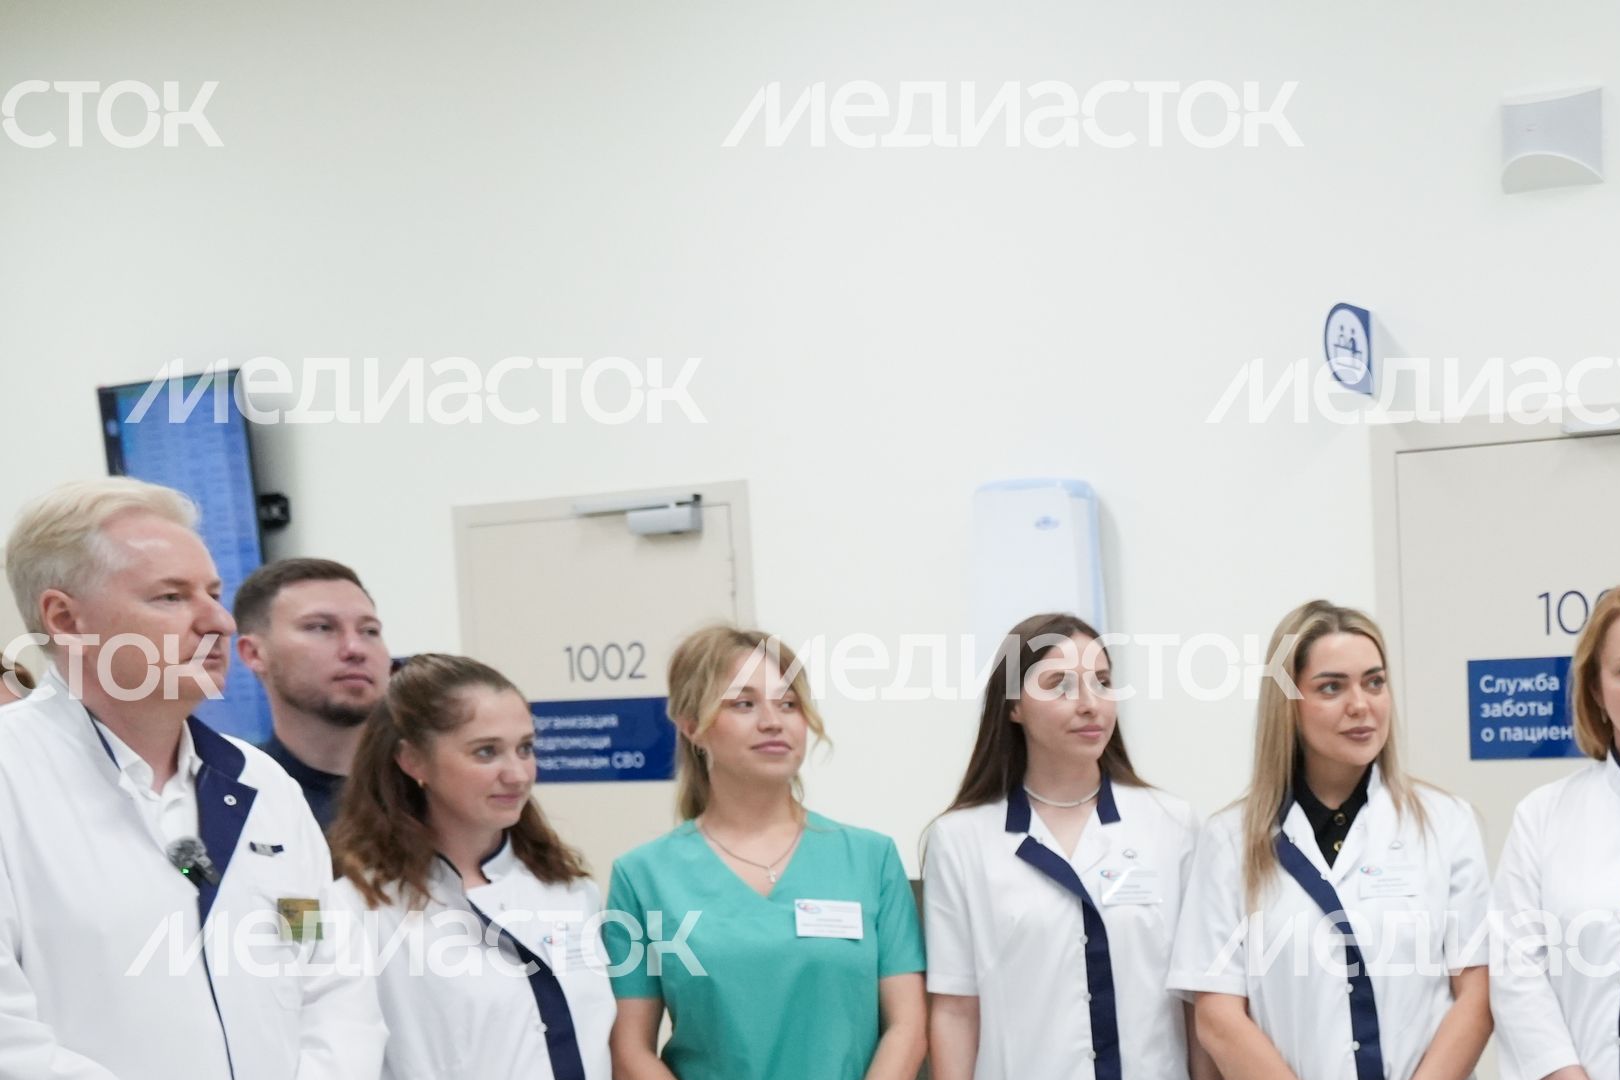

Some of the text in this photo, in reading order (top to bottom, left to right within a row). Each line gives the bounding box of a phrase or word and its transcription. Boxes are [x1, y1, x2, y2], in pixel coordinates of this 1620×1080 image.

[563, 641, 647, 683] 1002
[1479, 672, 1560, 696] Служба
[1480, 698, 1554, 718] заботы
[1480, 727, 1495, 743] о
[612, 751, 645, 768] СВО
